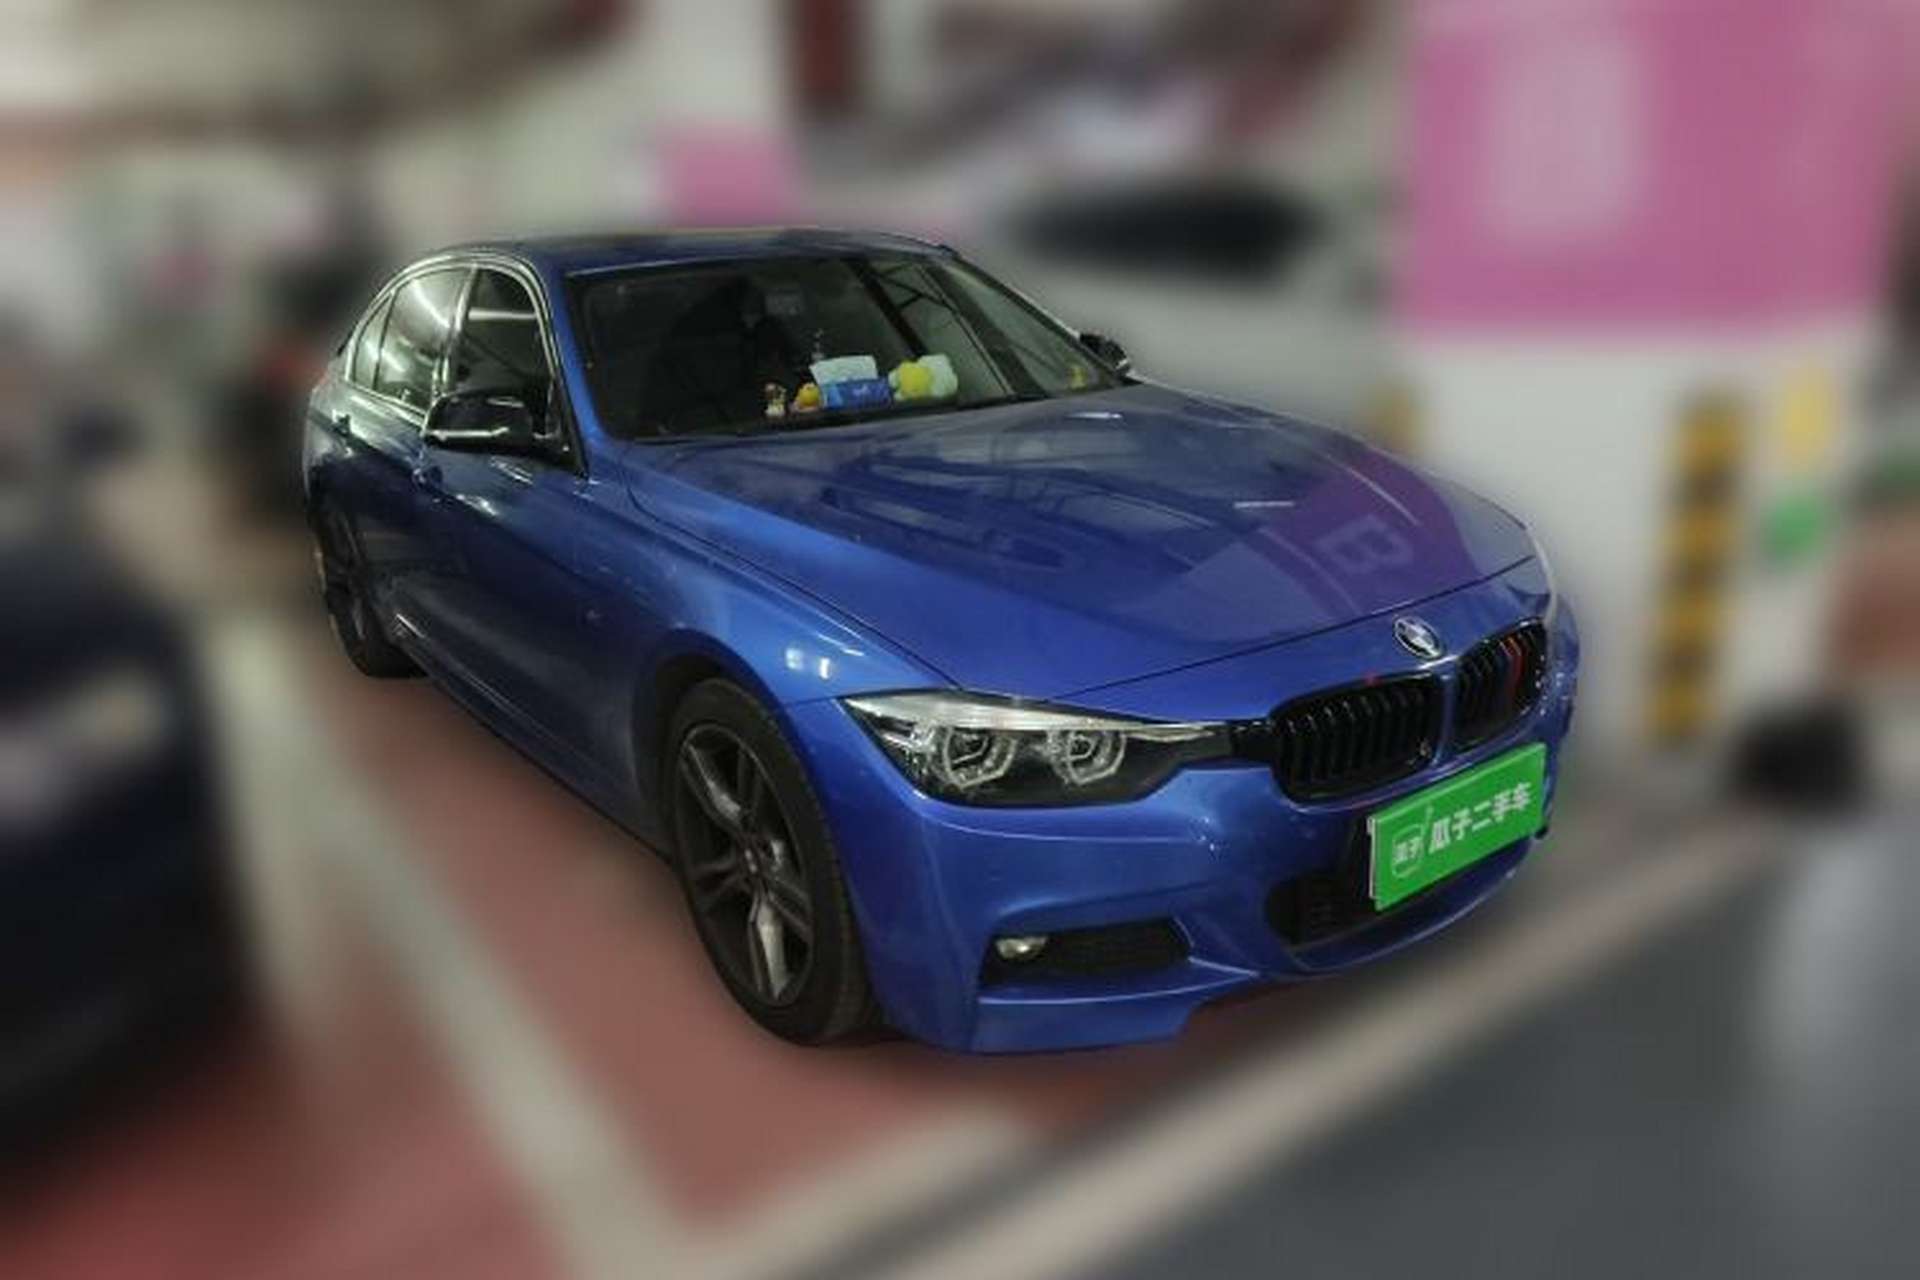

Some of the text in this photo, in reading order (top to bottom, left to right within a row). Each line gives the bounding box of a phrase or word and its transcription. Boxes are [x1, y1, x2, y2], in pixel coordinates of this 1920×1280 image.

[1428, 782, 1532, 854] 瓜子二手车
